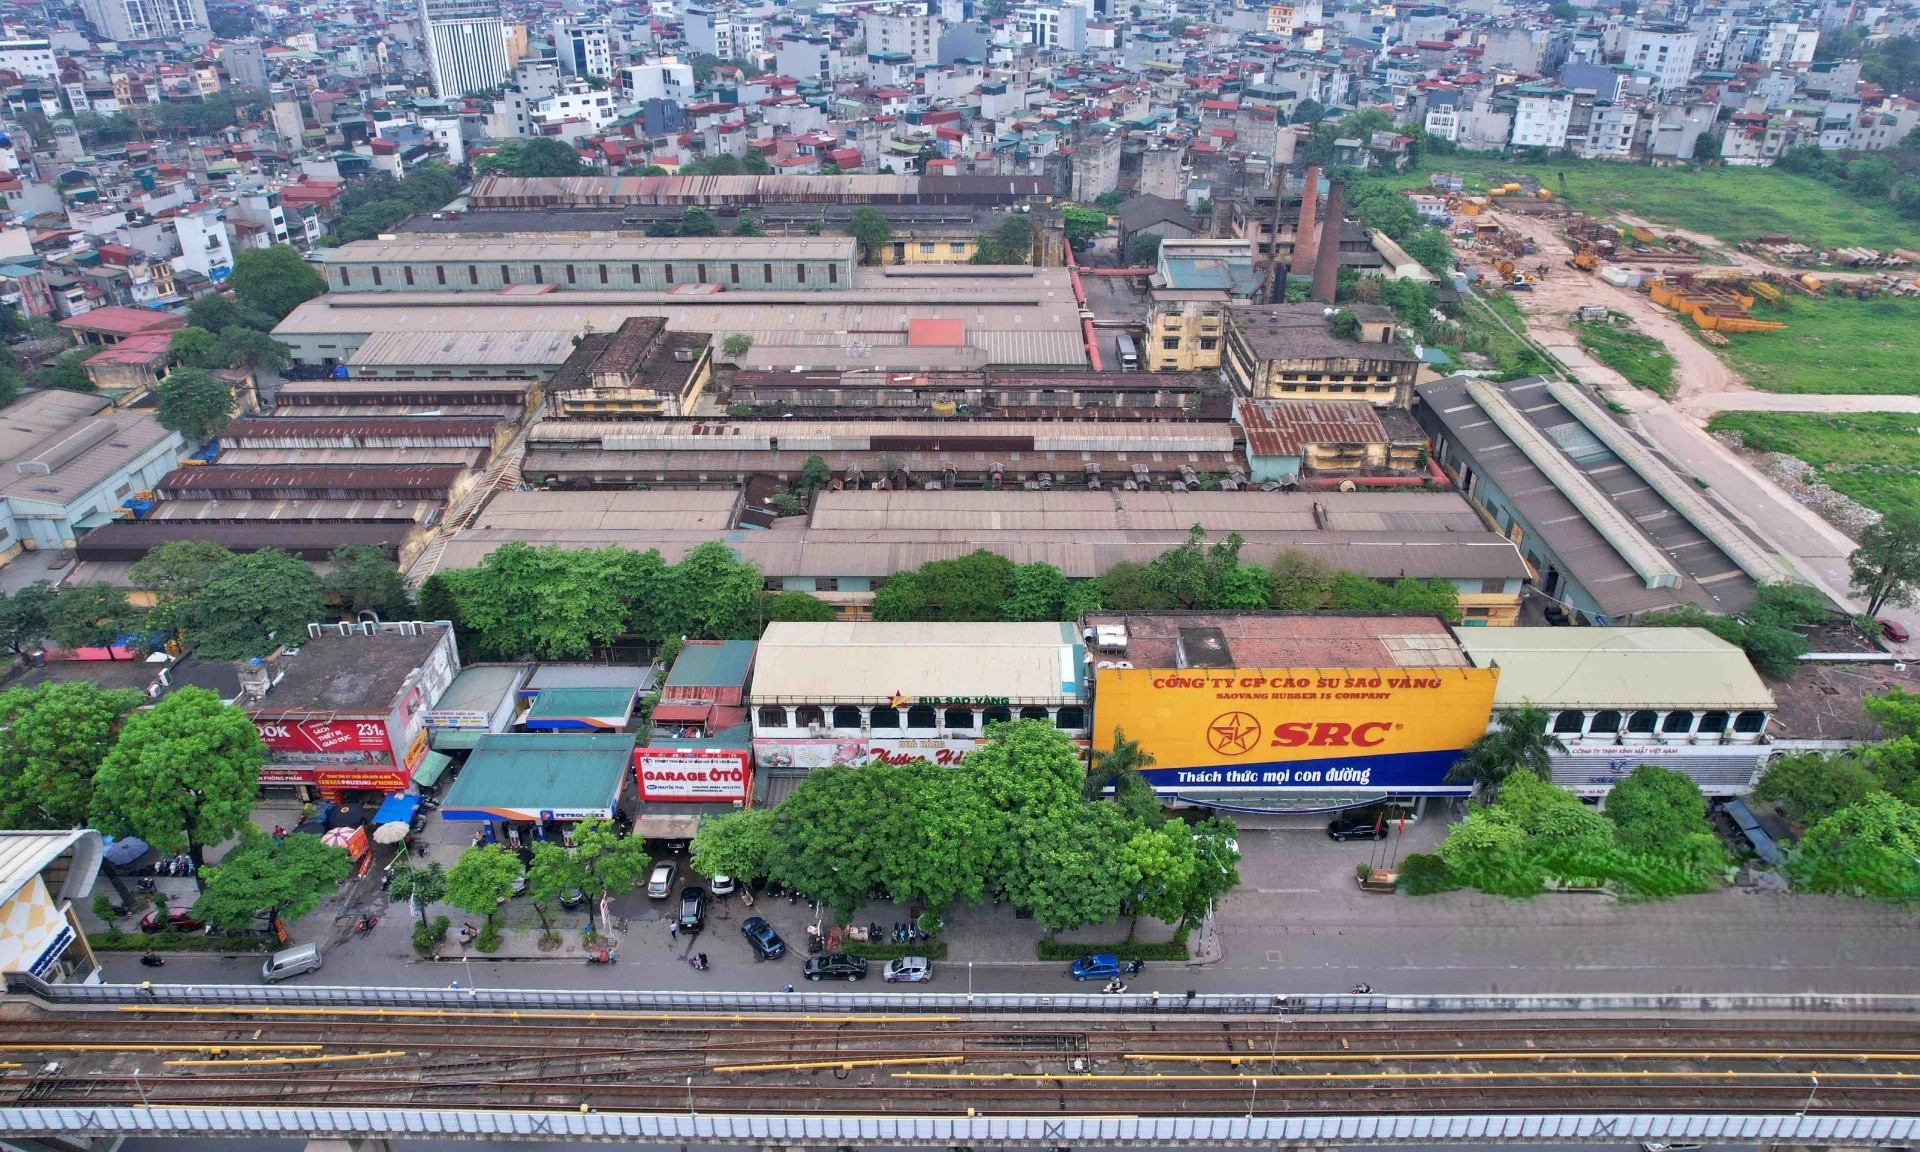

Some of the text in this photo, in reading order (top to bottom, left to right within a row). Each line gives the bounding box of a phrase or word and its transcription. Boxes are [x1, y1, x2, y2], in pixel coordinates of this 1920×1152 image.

[1153, 674, 1205, 689] CÔNG
[1211, 677, 1235, 688] TY
[1240, 677, 1267, 688] CP
[1270, 677, 1311, 688] CAO
[1317, 677, 1341, 688] SU
[1344, 677, 1382, 688] SAO
[919, 694, 1010, 705] BIA SAO VÀNG
[1216, 692, 1269, 700] SAOVANG
[1271, 692, 1317, 700] RUBBER
[1335, 692, 1391, 700] COMPANY
[1270, 721, 1393, 748] SRC
[644, 767, 743, 782] GARAGE ÔTÔ
[1177, 767, 1372, 785] Thách thức mọi con đường
